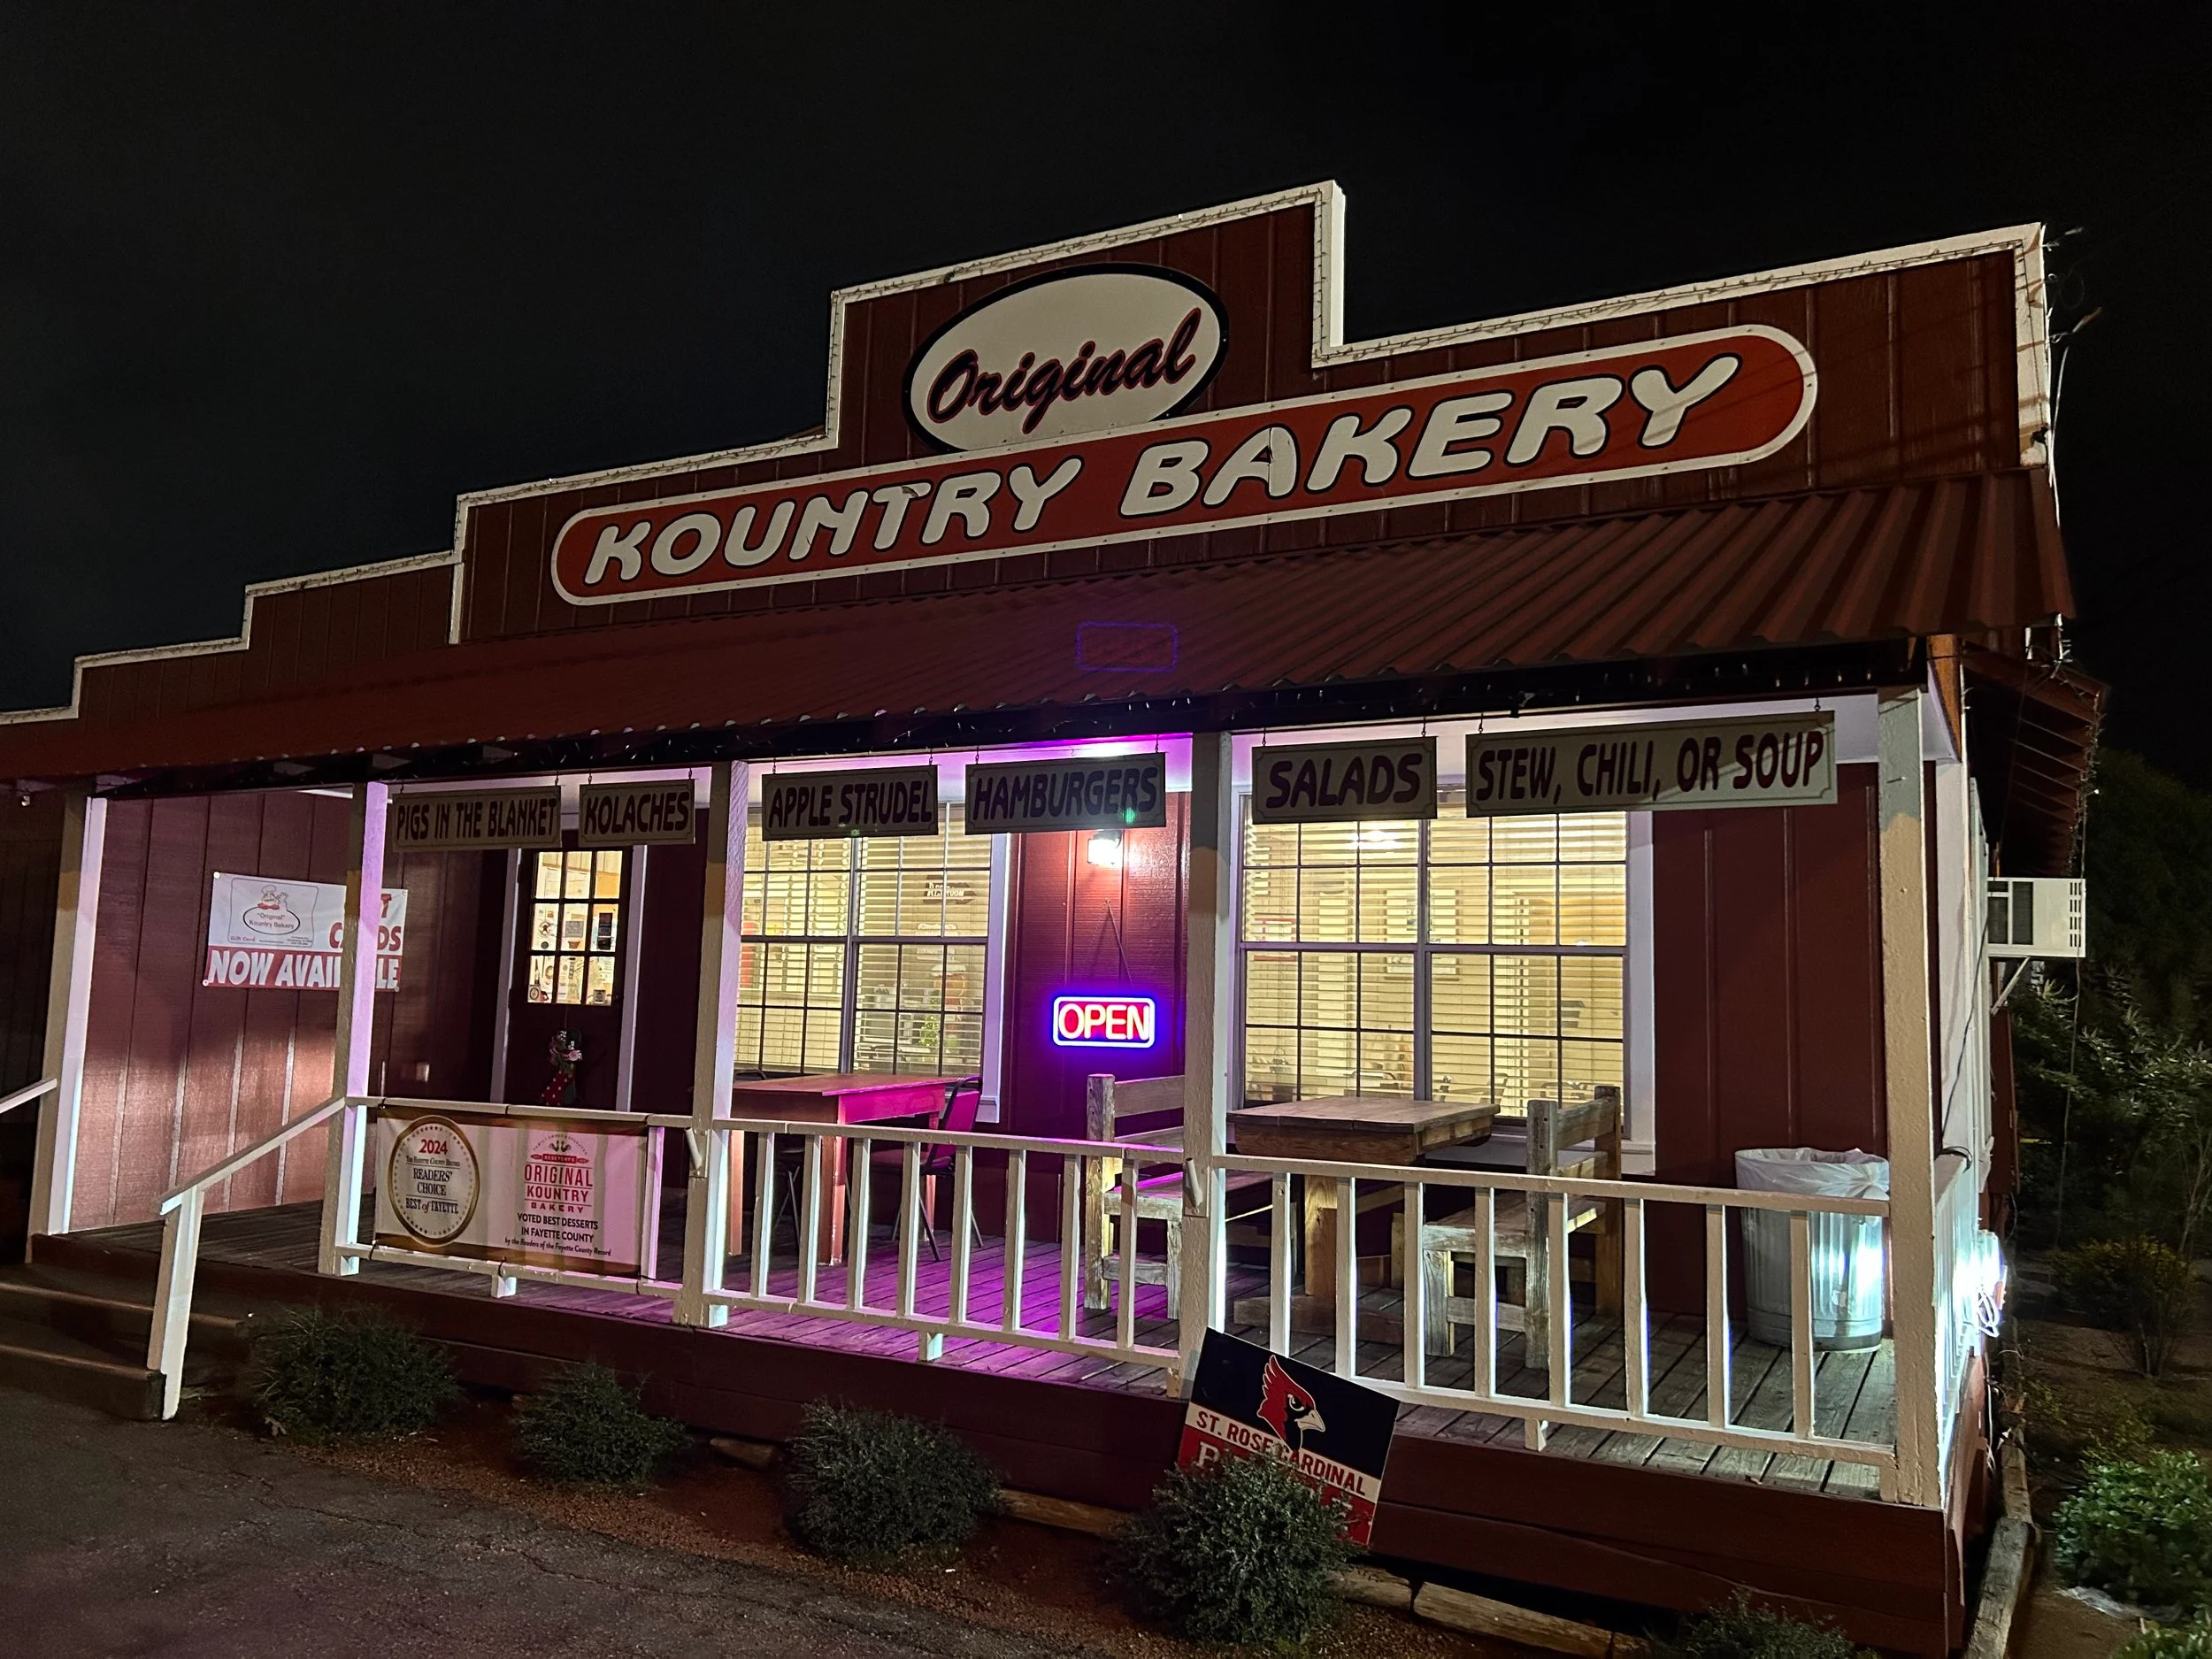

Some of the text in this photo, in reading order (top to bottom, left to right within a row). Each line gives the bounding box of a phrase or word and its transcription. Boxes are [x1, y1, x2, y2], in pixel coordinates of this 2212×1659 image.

[926, 307, 1202, 434] Original
[583, 352, 1742, 586] KOUNTRY BAKERY
[1265, 753, 1423, 809] SALADS
[1476, 731, 1824, 805] STEW, CHILI, OR SOUP
[768, 780, 933, 829] APPLE STRUDEL
[972, 766, 1159, 821] HAMBURGERS
[396, 798, 557, 841] PIGS IN THE BLANKET
[584, 791, 690, 835] KOLACHES
[329, 922, 402, 951] CDS
[208, 949, 274, 986] NOW
[1058, 1003, 1150, 1041] OPEN
[419, 1139, 449, 1156] 2024
[417, 1181, 447, 1195] CHOICE
[525, 1164, 593, 1187] ORIGINAL
[527, 1185, 588, 1202] KOUNTRY
[405, 1197, 459, 1214] BEST of FAYETTE
[517, 1213, 598, 1230] VOTED BEST DESSERTS
[531, 1202, 584, 1213] BAKERY
[504, 1237, 511, 1246] by
[520, 1238, 539, 1248] Readers
[540, 1240, 546, 1250] of
[555, 1242, 573, 1253] Fayette
[574, 1245, 593, 1256] County
[594, 1247, 611, 1256] Record
[521, 1226, 594, 1243] IN FAYETTE COUNTY
[1196, 1410, 1222, 1436] ST.
[1226, 1422, 1273, 1453] ROSE
